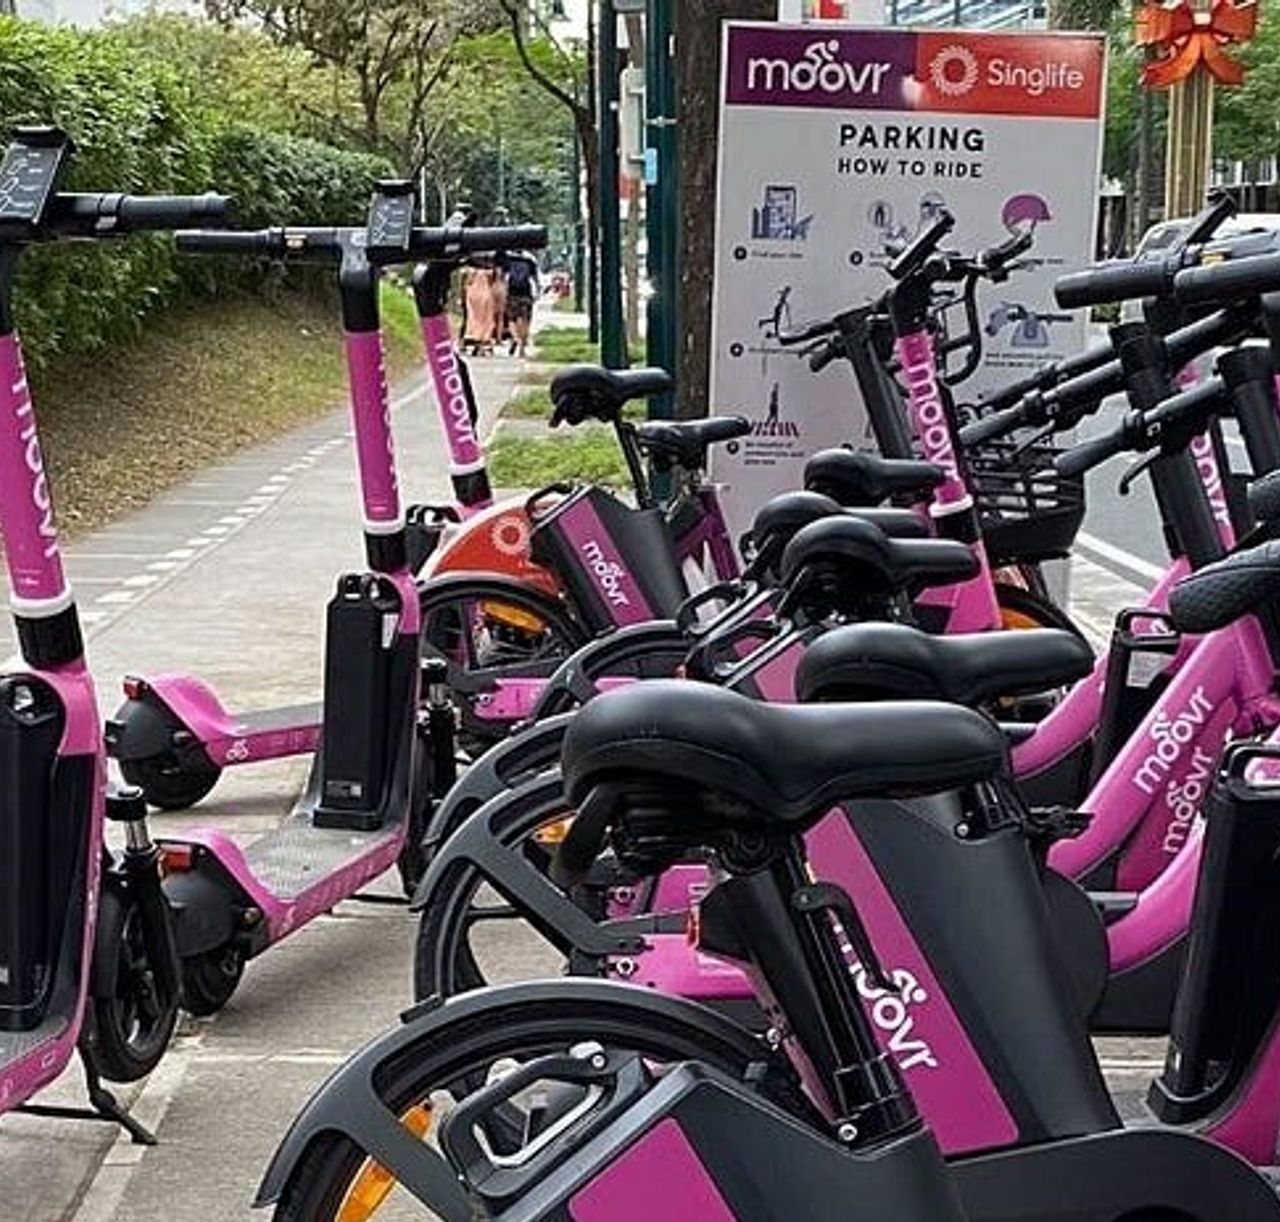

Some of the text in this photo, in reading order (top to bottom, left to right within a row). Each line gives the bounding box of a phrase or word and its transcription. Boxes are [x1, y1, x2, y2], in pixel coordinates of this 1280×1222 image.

[747, 46, 890, 94] moovr
[987, 58, 1085, 96] Singlife
[838, 158, 983, 178] HOW TO RIDE
[839, 124, 985, 152] PARKING
[434, 340, 476, 444] moovr
[1190, 430, 1231, 526] oovr
[582, 541, 630, 606] moovr
[1132, 685, 1214, 793] moovr
[1162, 747, 1213, 853] moovr
[832, 922, 938, 1070] oovr
